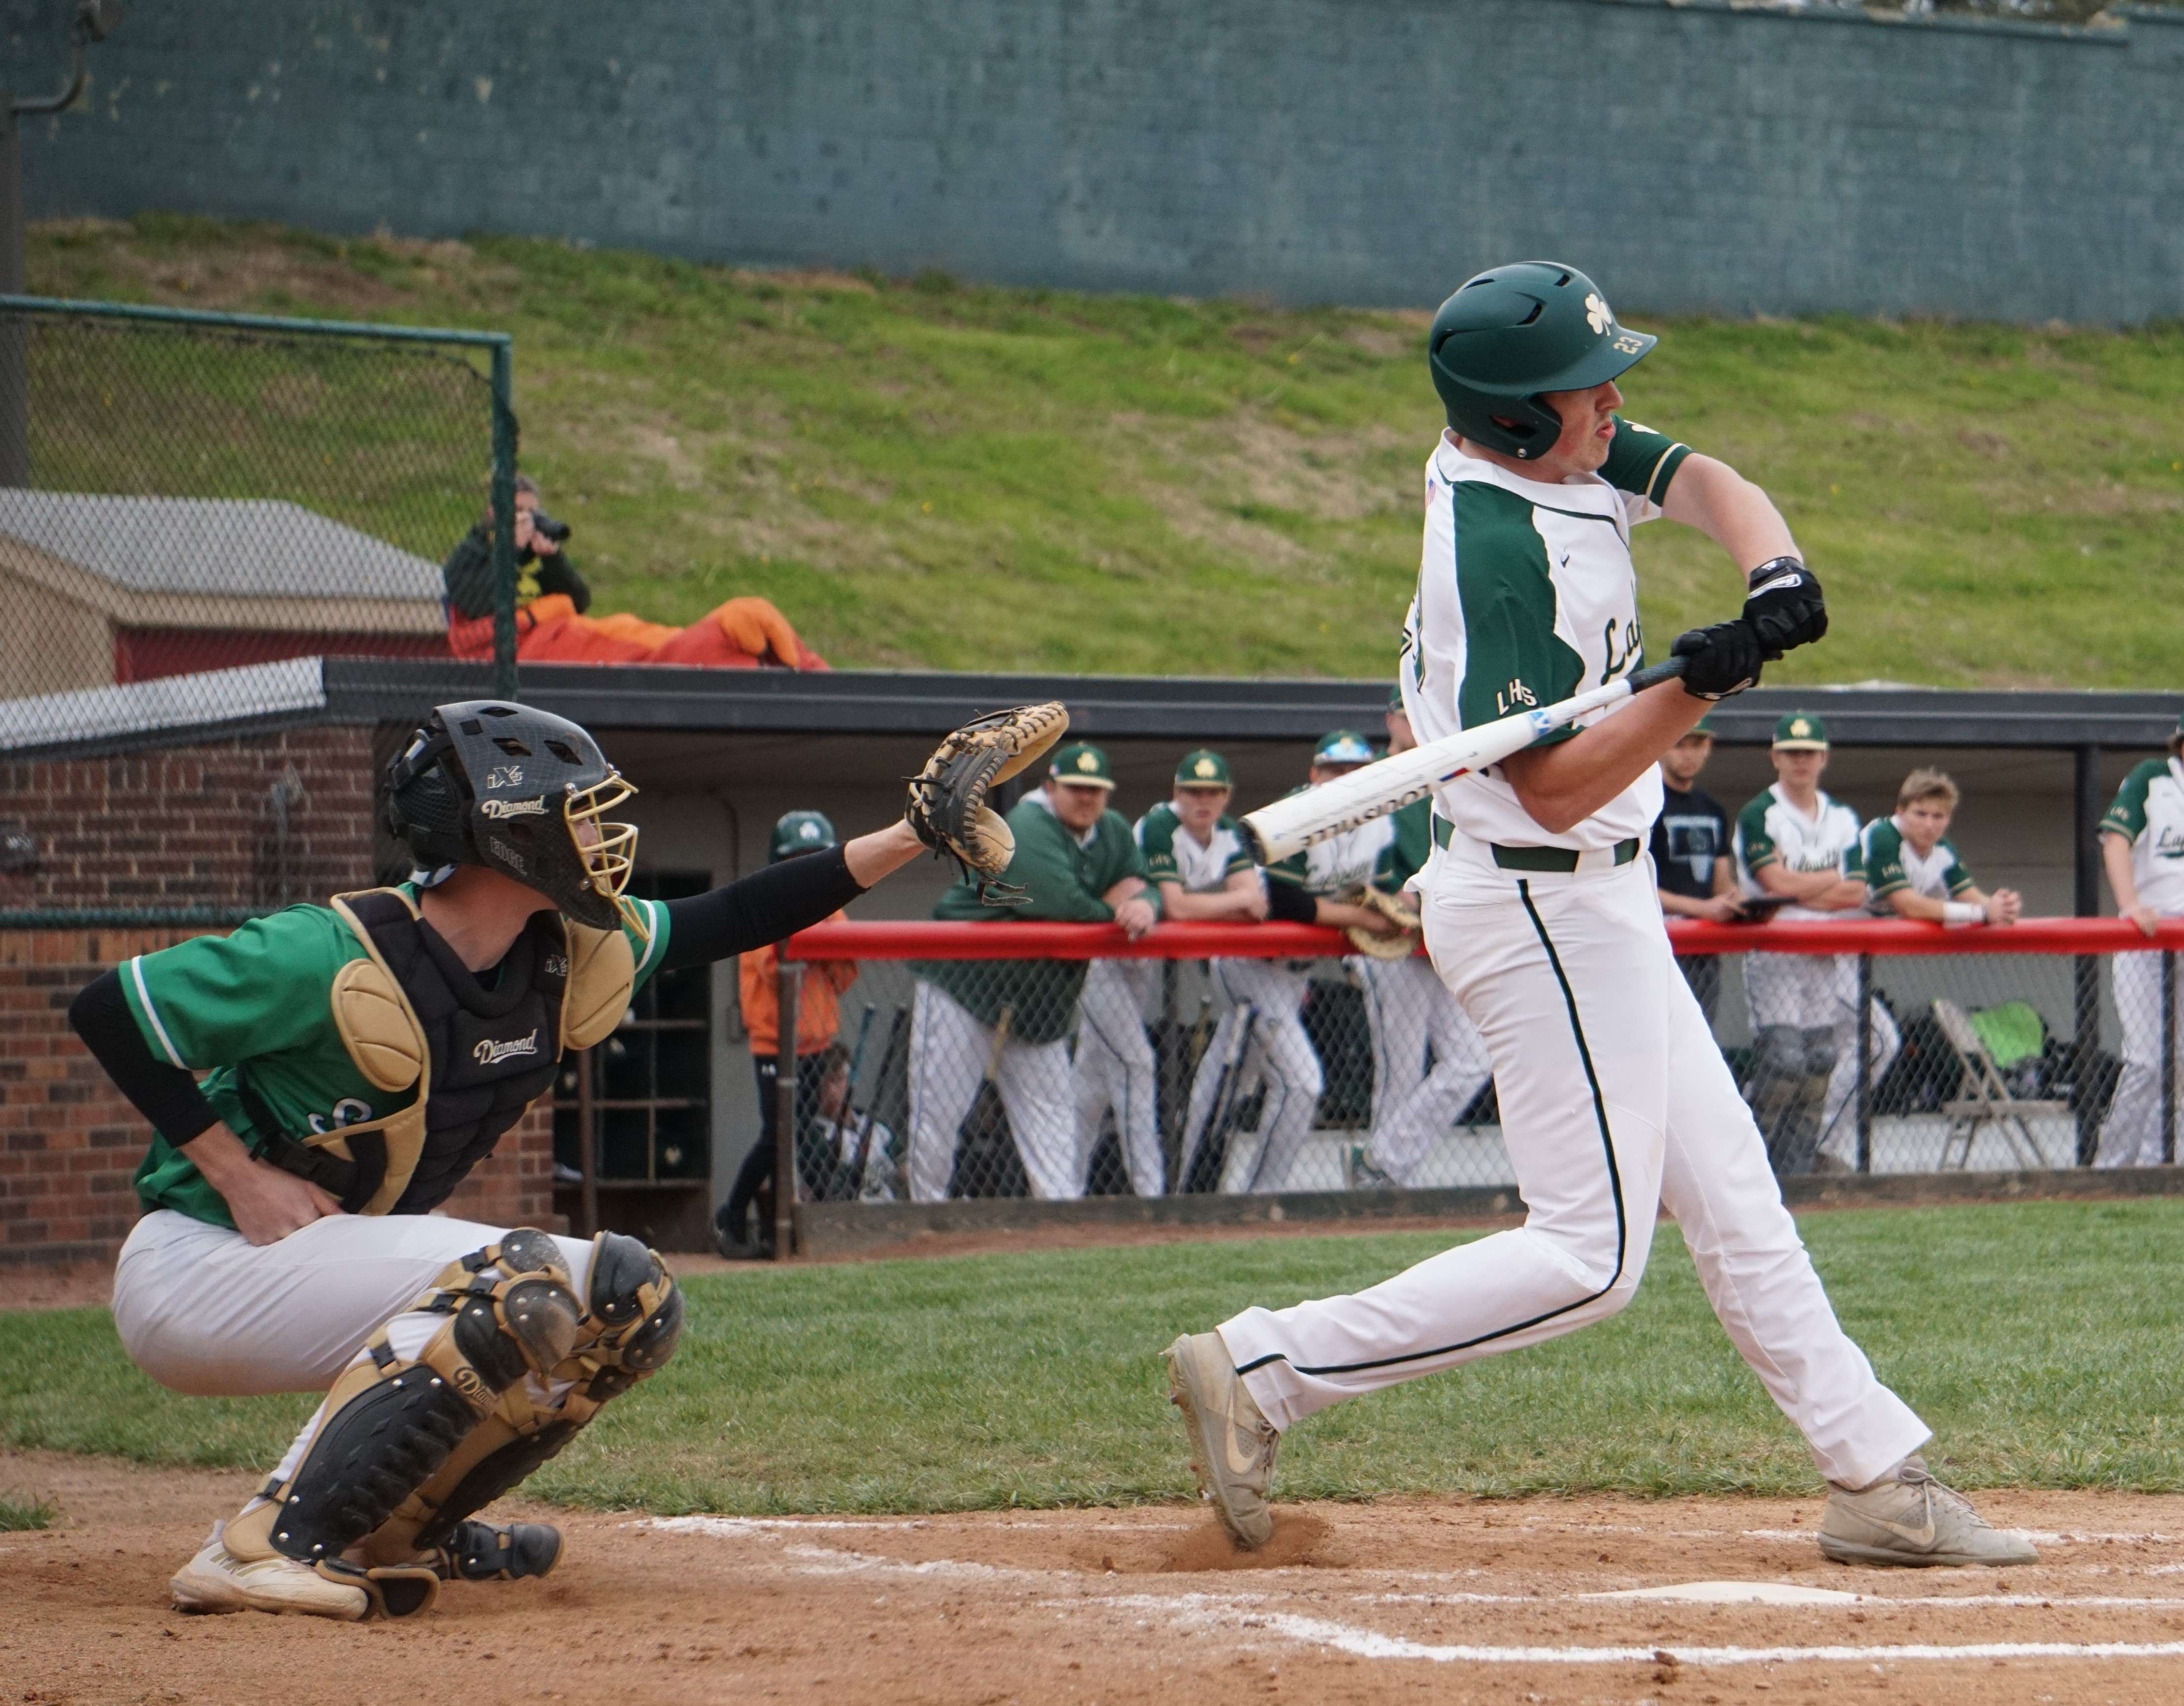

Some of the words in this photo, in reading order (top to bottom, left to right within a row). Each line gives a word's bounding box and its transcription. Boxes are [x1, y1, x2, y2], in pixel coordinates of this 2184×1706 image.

[1613, 337, 1643, 354] 23
[1600, 617, 1641, 686] La
[1497, 679, 1537, 716] LHS
[481, 795, 549, 819] Diamond
[489, 836, 527, 877] EDGE
[473, 1028, 538, 1066] Diamond
